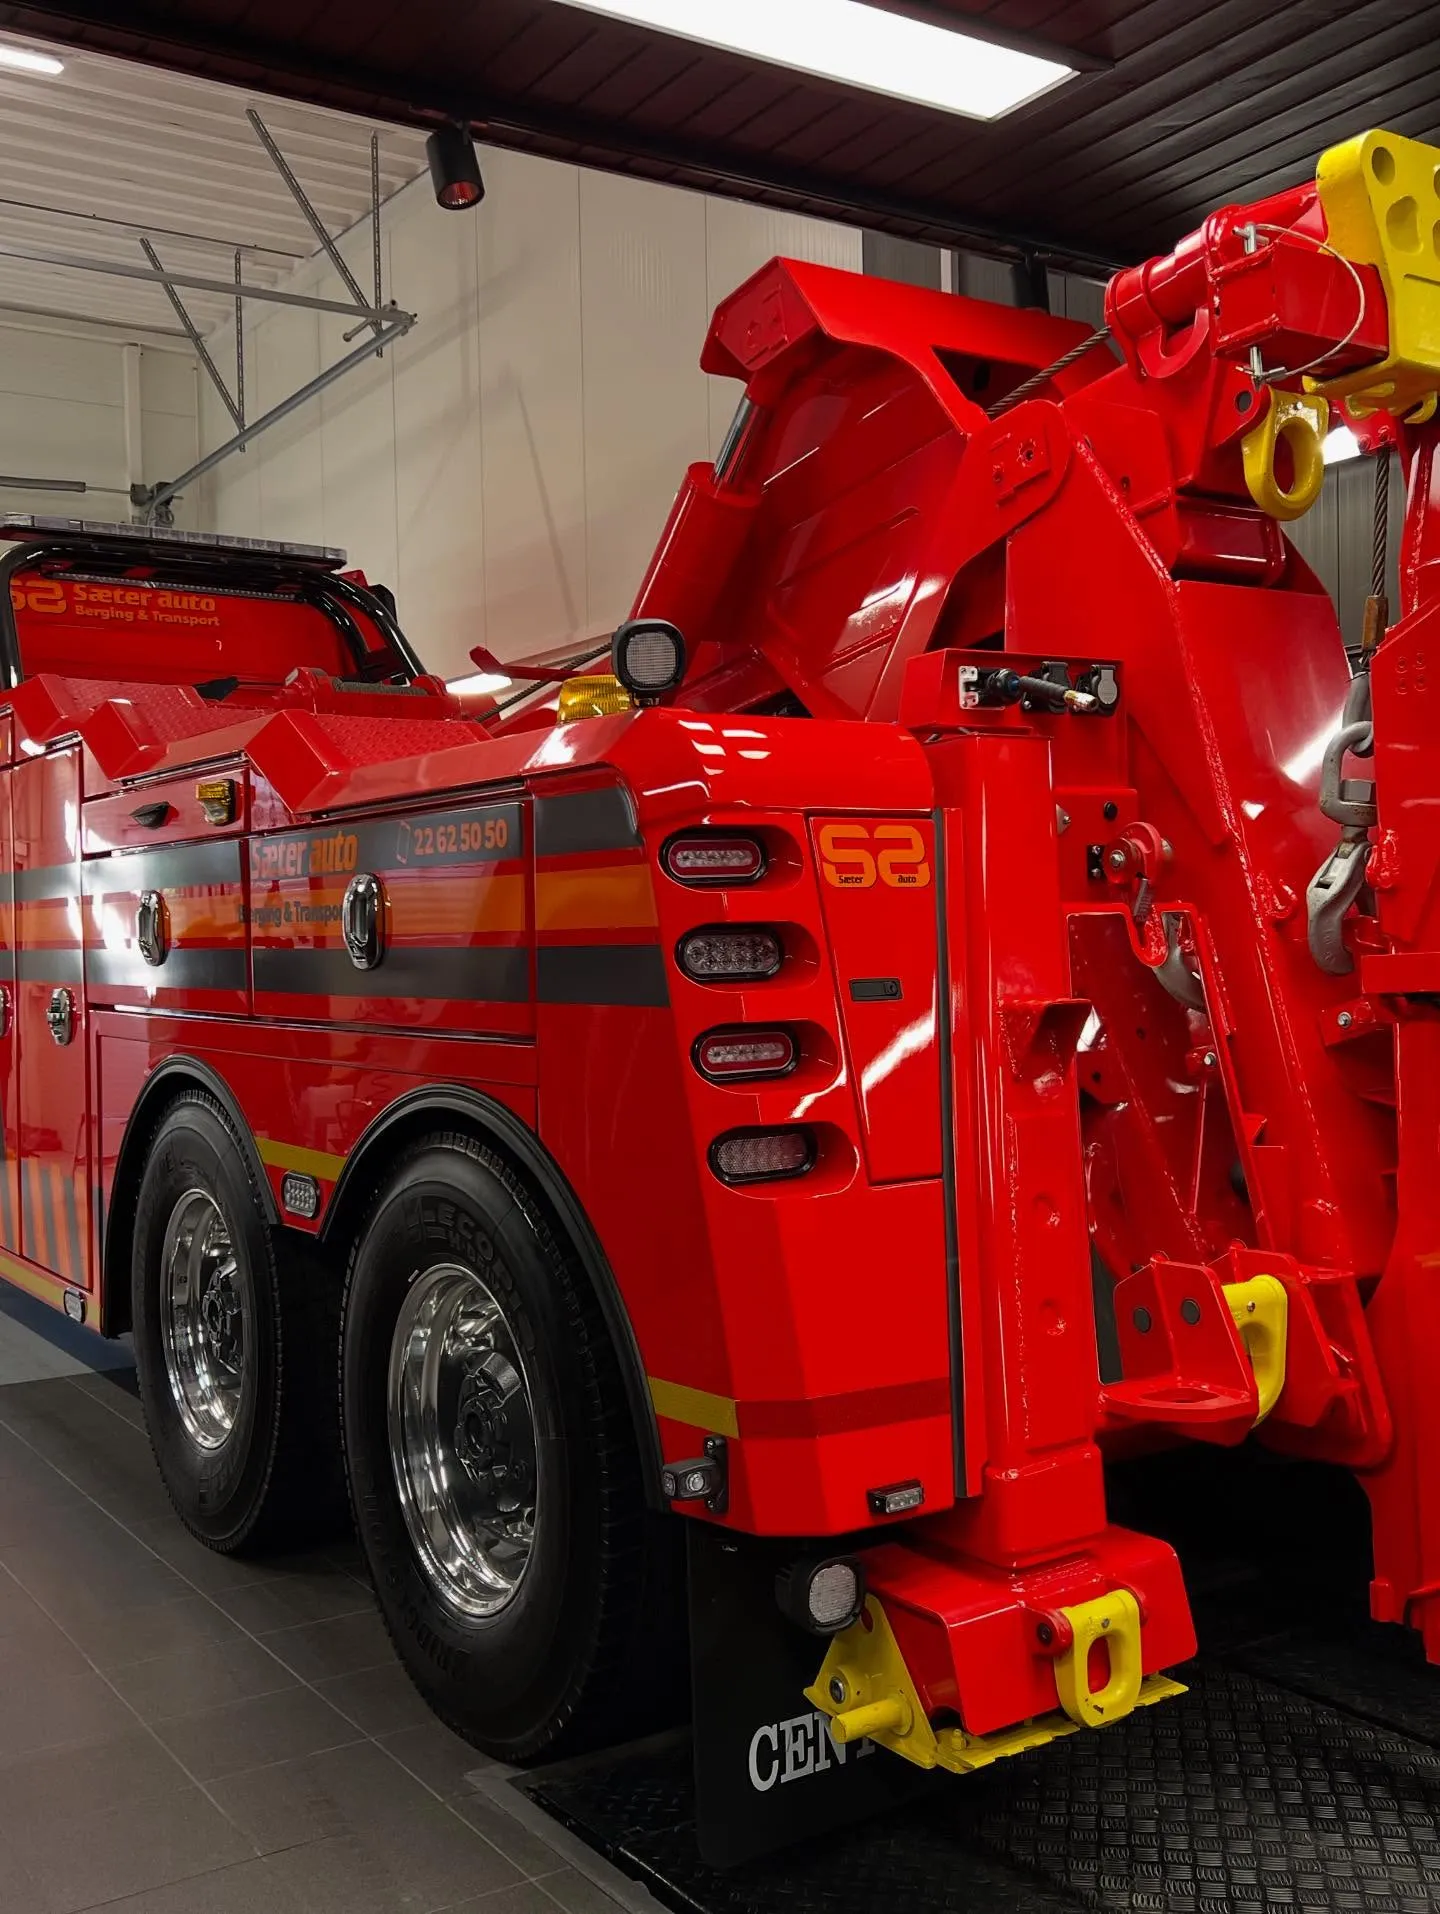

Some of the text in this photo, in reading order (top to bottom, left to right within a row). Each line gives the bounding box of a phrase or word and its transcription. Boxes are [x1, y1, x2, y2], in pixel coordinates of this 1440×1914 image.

[73, 583, 216, 612] Sæter auto
[75, 605, 220, 627] Berging & Transport
[414, 818, 508, 856] 22 62 50 50
[250, 829, 359, 879] Sæter auto
[838, 874, 864, 884] Sæter
[238, 902, 281, 928] Berging
[283, 901, 292, 921] &
[748, 1711, 875, 1792] CEN
